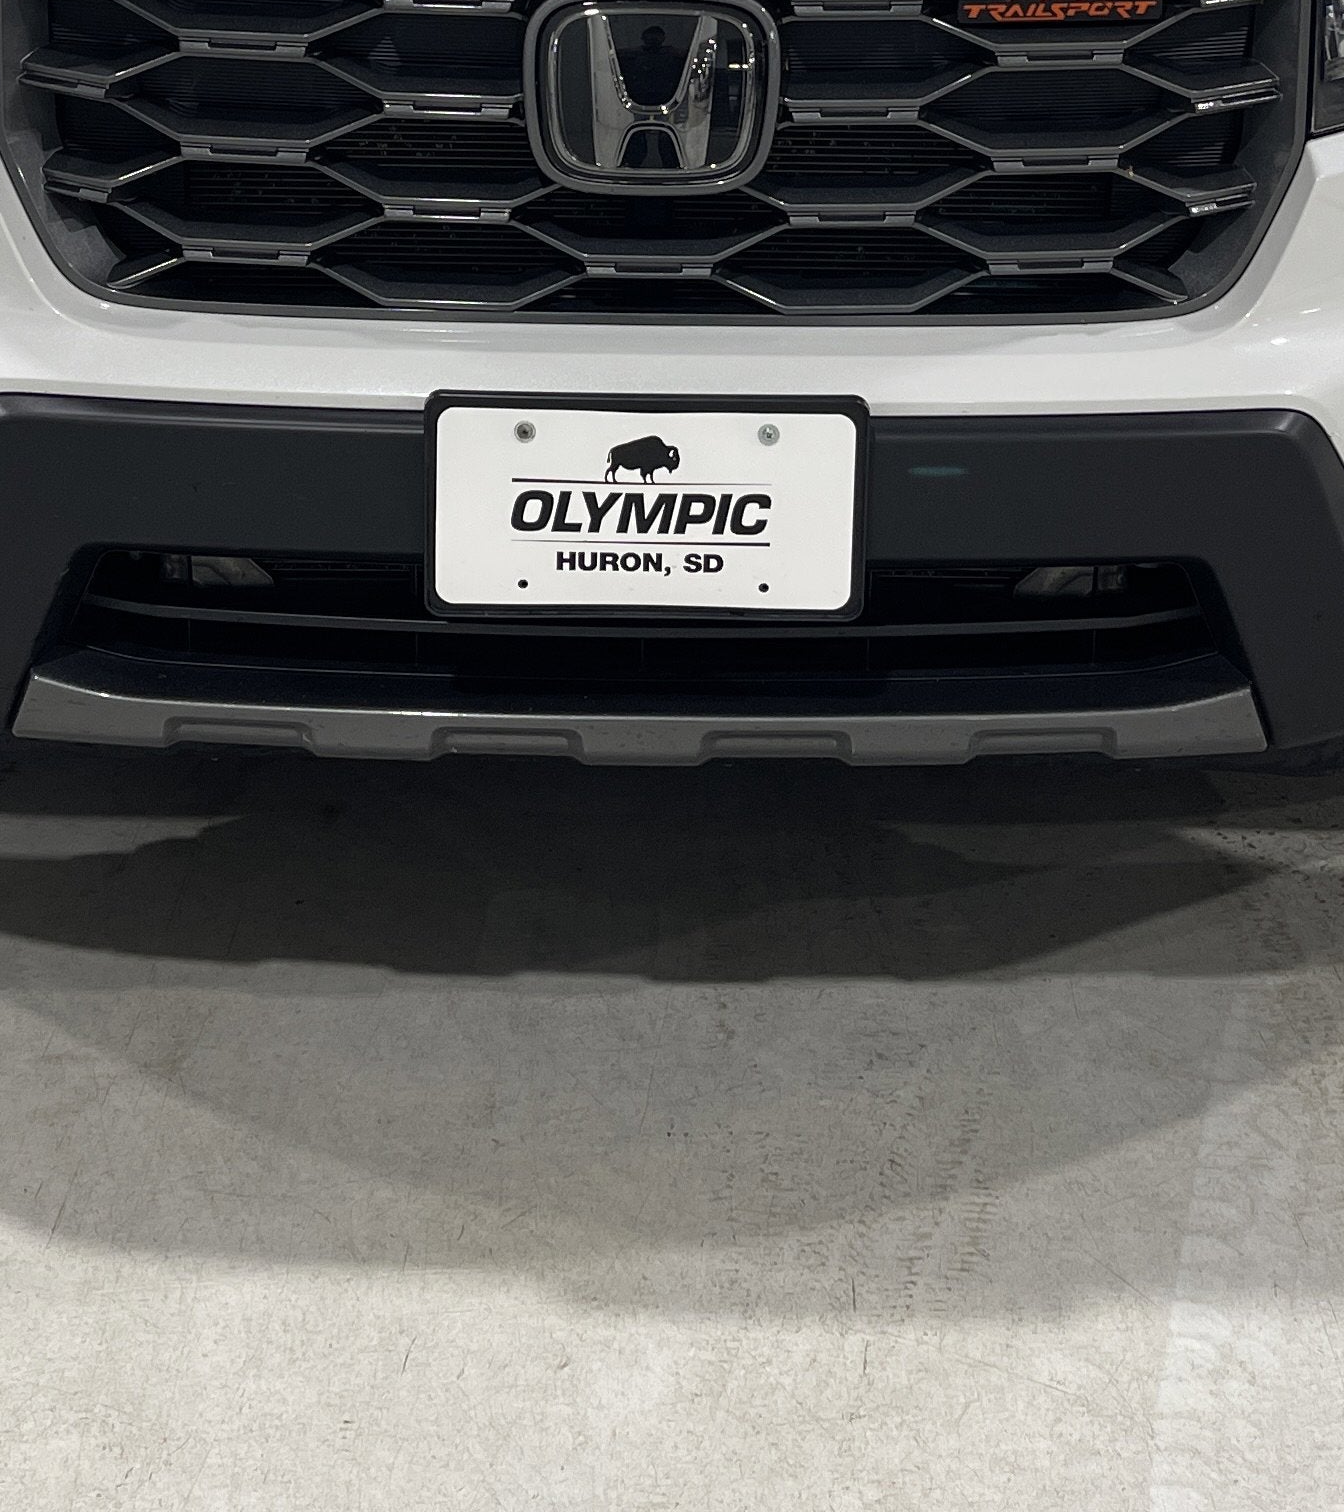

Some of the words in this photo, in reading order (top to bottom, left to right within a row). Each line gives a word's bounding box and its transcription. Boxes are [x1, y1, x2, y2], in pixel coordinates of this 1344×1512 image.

[962, 0, 1158, 21] TRAILSPORT
[510, 489, 772, 536] OLYMPIC
[556, 551, 672, 577] HURON,
[683, 553, 724, 574] SD
